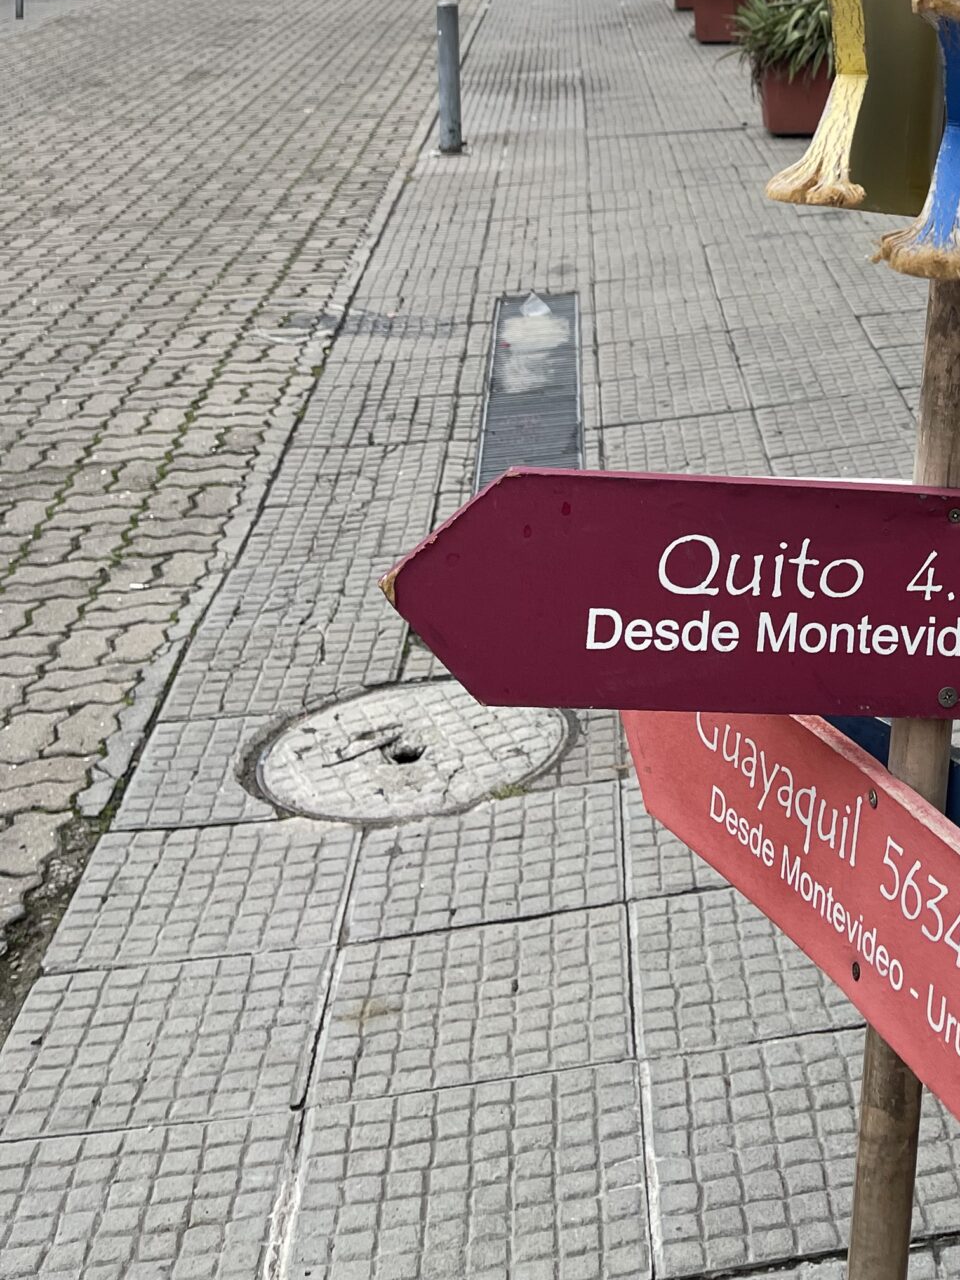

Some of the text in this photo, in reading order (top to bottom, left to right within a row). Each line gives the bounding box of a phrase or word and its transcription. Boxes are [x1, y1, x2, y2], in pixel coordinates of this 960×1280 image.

[658, 534, 864, 599] Quito
[585, 607, 740, 652] Desde
[709, 784, 775, 867] Desde
[780, 844, 904, 991] Montevideo
